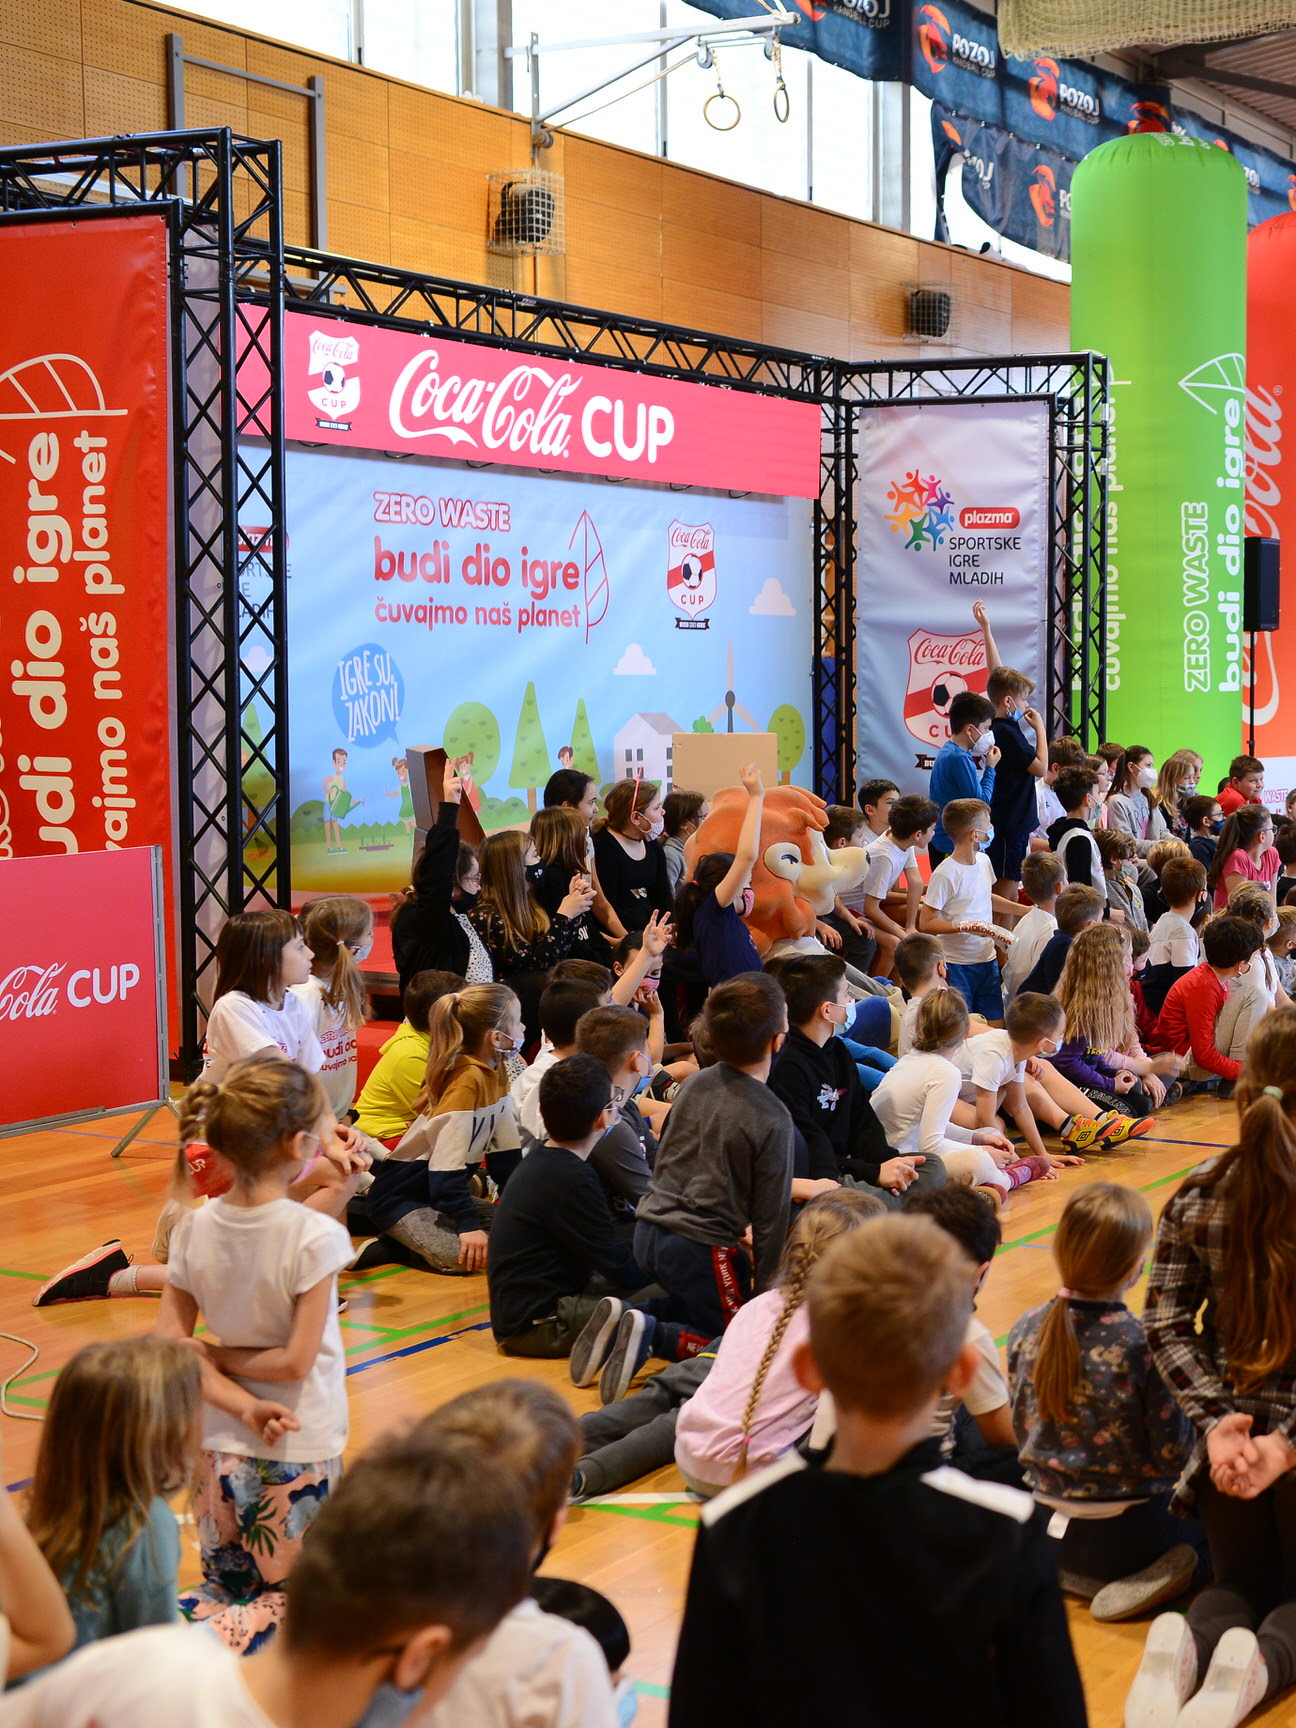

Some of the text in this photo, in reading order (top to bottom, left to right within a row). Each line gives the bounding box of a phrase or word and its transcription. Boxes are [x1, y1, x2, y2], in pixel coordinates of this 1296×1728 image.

[952, 33, 995, 69] POZOJ
[1059, 83, 1100, 116] POZOJ
[321, 396, 347, 409] CUP
[389, 349, 675, 463] Coca-Cola CUP
[13, 431, 73, 584] igre
[72, 430, 126, 595] planet
[374, 491, 511, 532] ZERO WASTE
[964, 510, 1014, 527] plazma
[671, 526, 711, 550] Coca-Cola
[949, 536, 1021, 550] SPORTSKE
[1216, 398, 1245, 692] budi dio igre
[374, 535, 580, 600] budi dio igre
[949, 554, 980, 568] IGRE
[949, 572, 1004, 585] MLADIH
[375, 596, 580, 633] čuvajmo naš planet
[680, 594, 704, 605] CUP
[1181, 501, 1210, 693] ZERO WASTE
[12, 609, 68, 730] dio
[80, 611, 123, 699] naš
[914, 637, 986, 666] Coca-Cola
[338, 650, 373, 700] IGRE
[67, 963, 140, 1008] CUP
